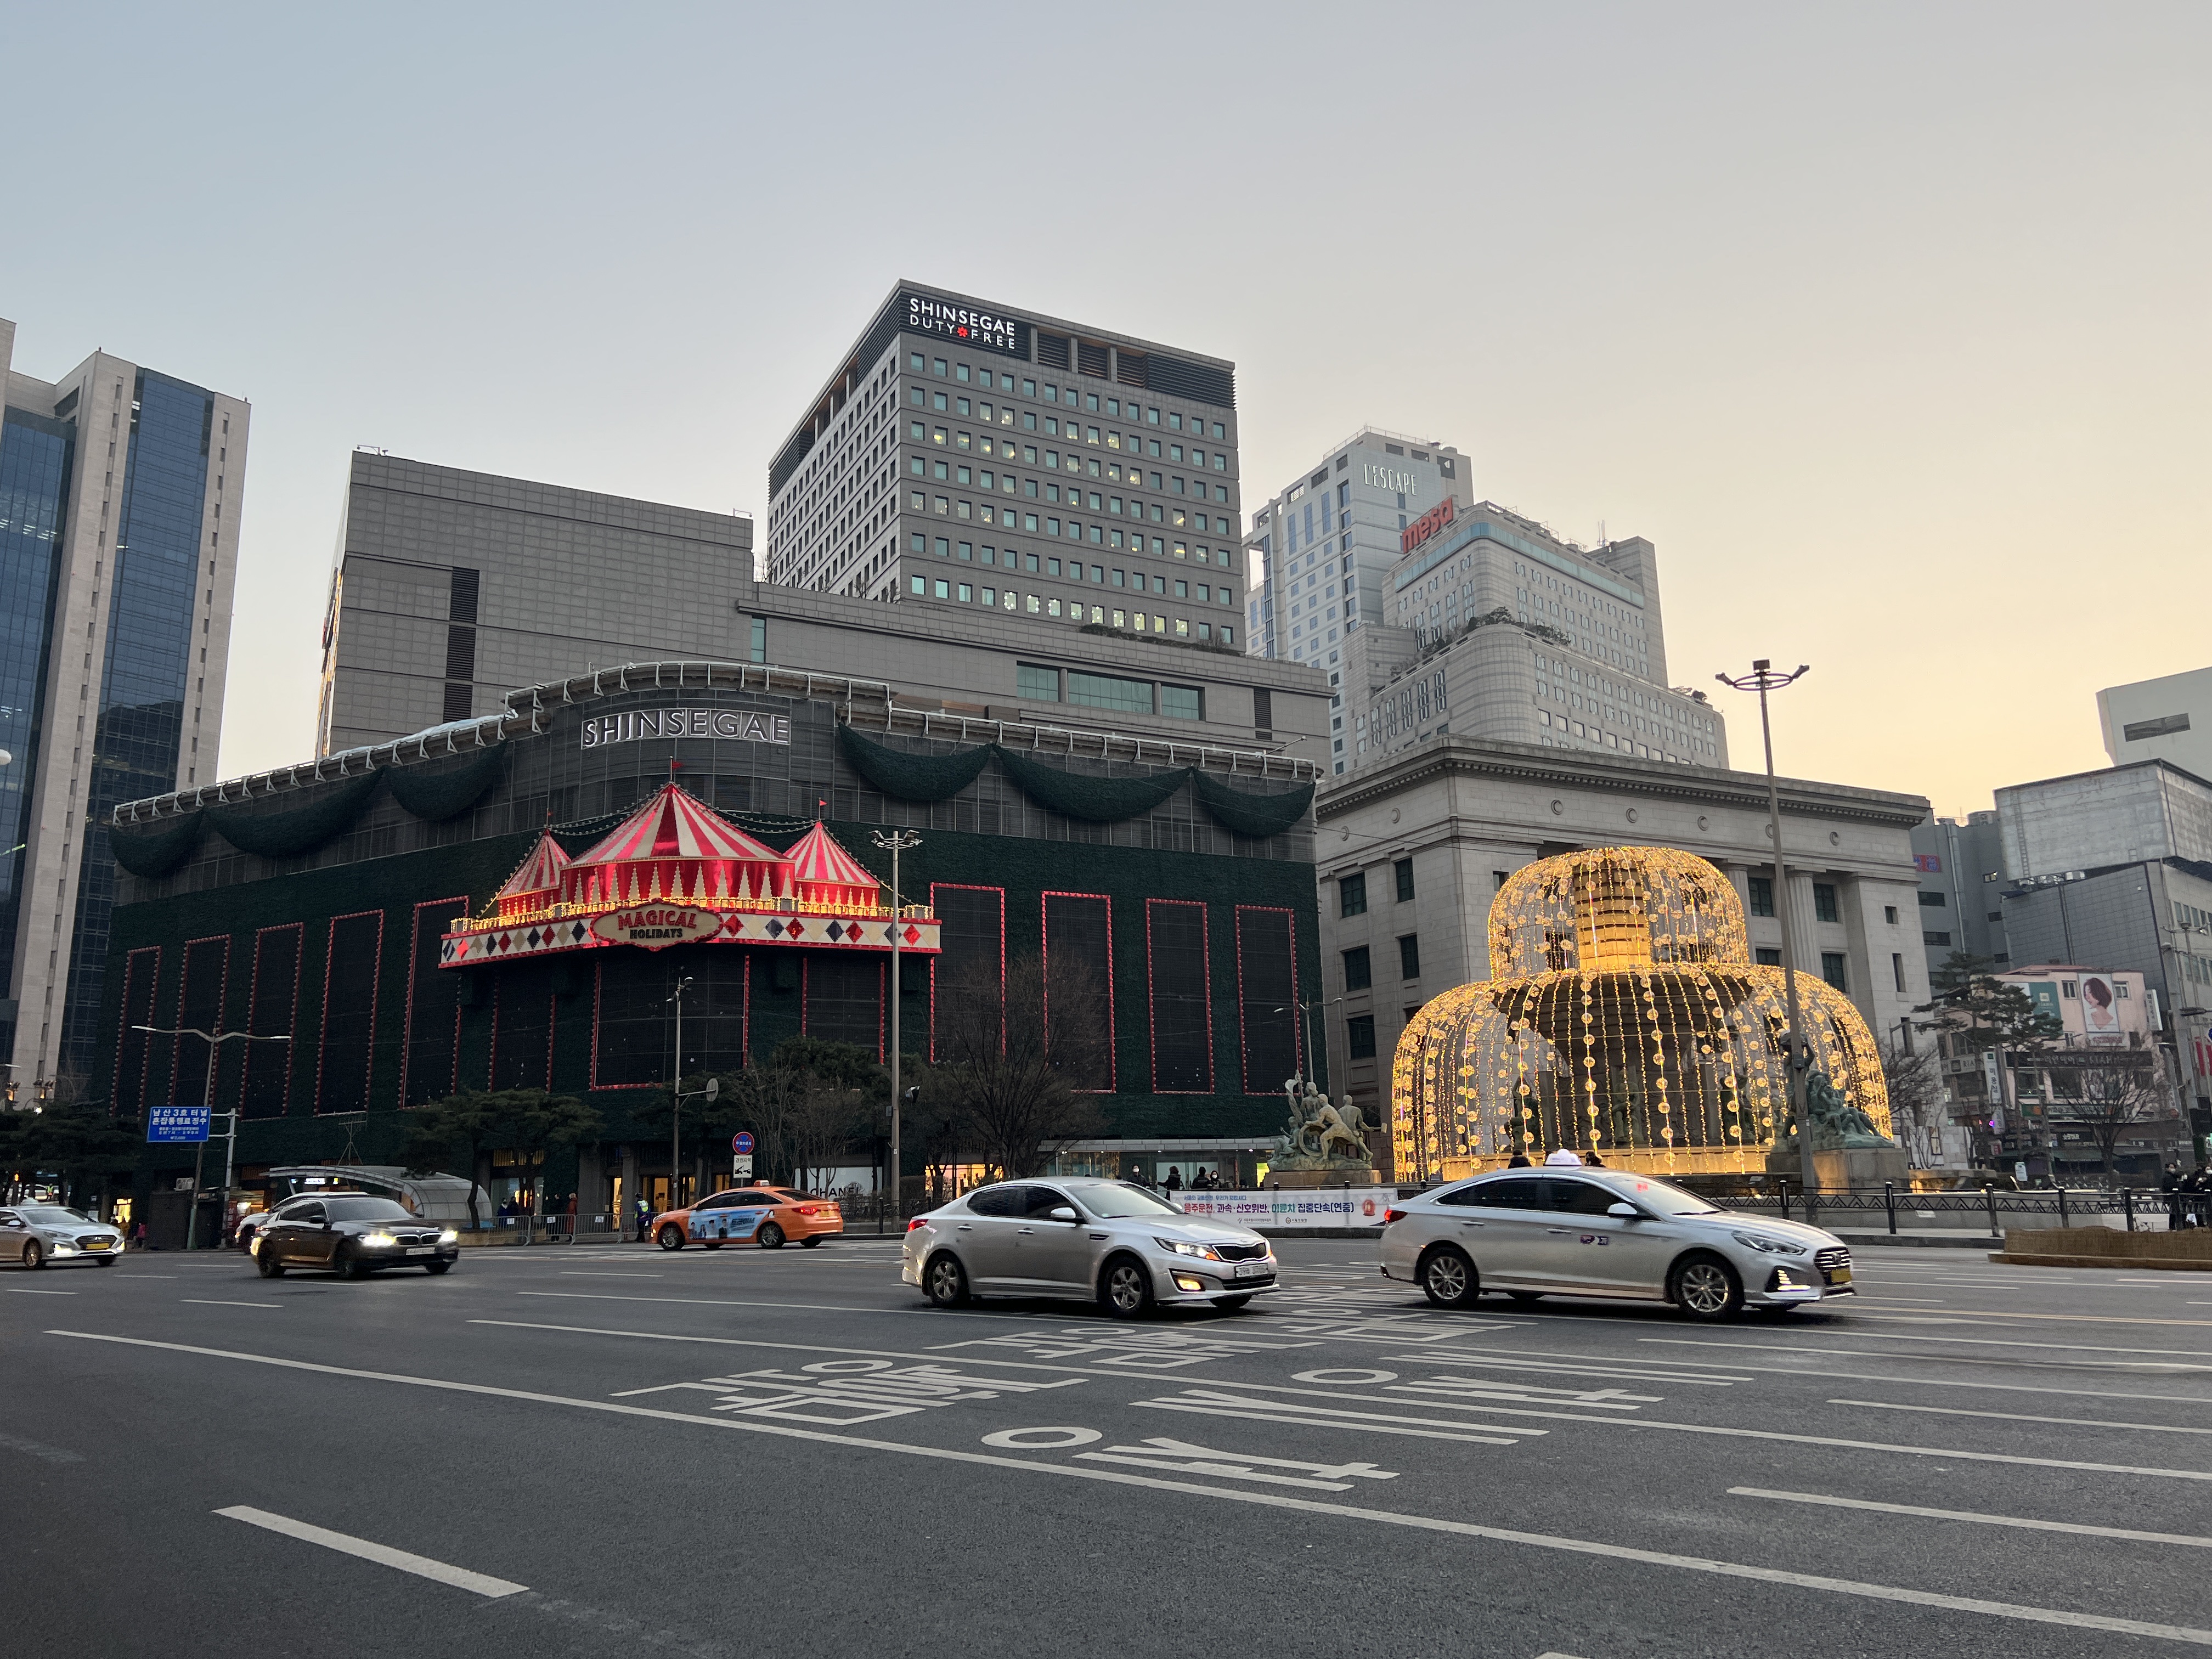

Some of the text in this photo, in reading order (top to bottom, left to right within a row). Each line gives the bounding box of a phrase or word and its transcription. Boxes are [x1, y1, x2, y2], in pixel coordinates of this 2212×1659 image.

[910, 298, 1015, 336] SHINSEGAE
[910, 314, 1015, 349] DUTY FREE
[1364, 464, 1417, 496] L'ESCAPE
[1402, 496, 1453, 554] mesa
[582, 710, 789, 747] SHINSEGAE
[617, 910, 697, 930] MAGICAL
[630, 928, 683, 939] HOLIDAYS
[1184, 1203, 1215, 1214] 음주운전,
[1272, 1203, 1296, 1213] 이륜차
[1297, 1201, 1355, 1213] 집중단속(연중)
